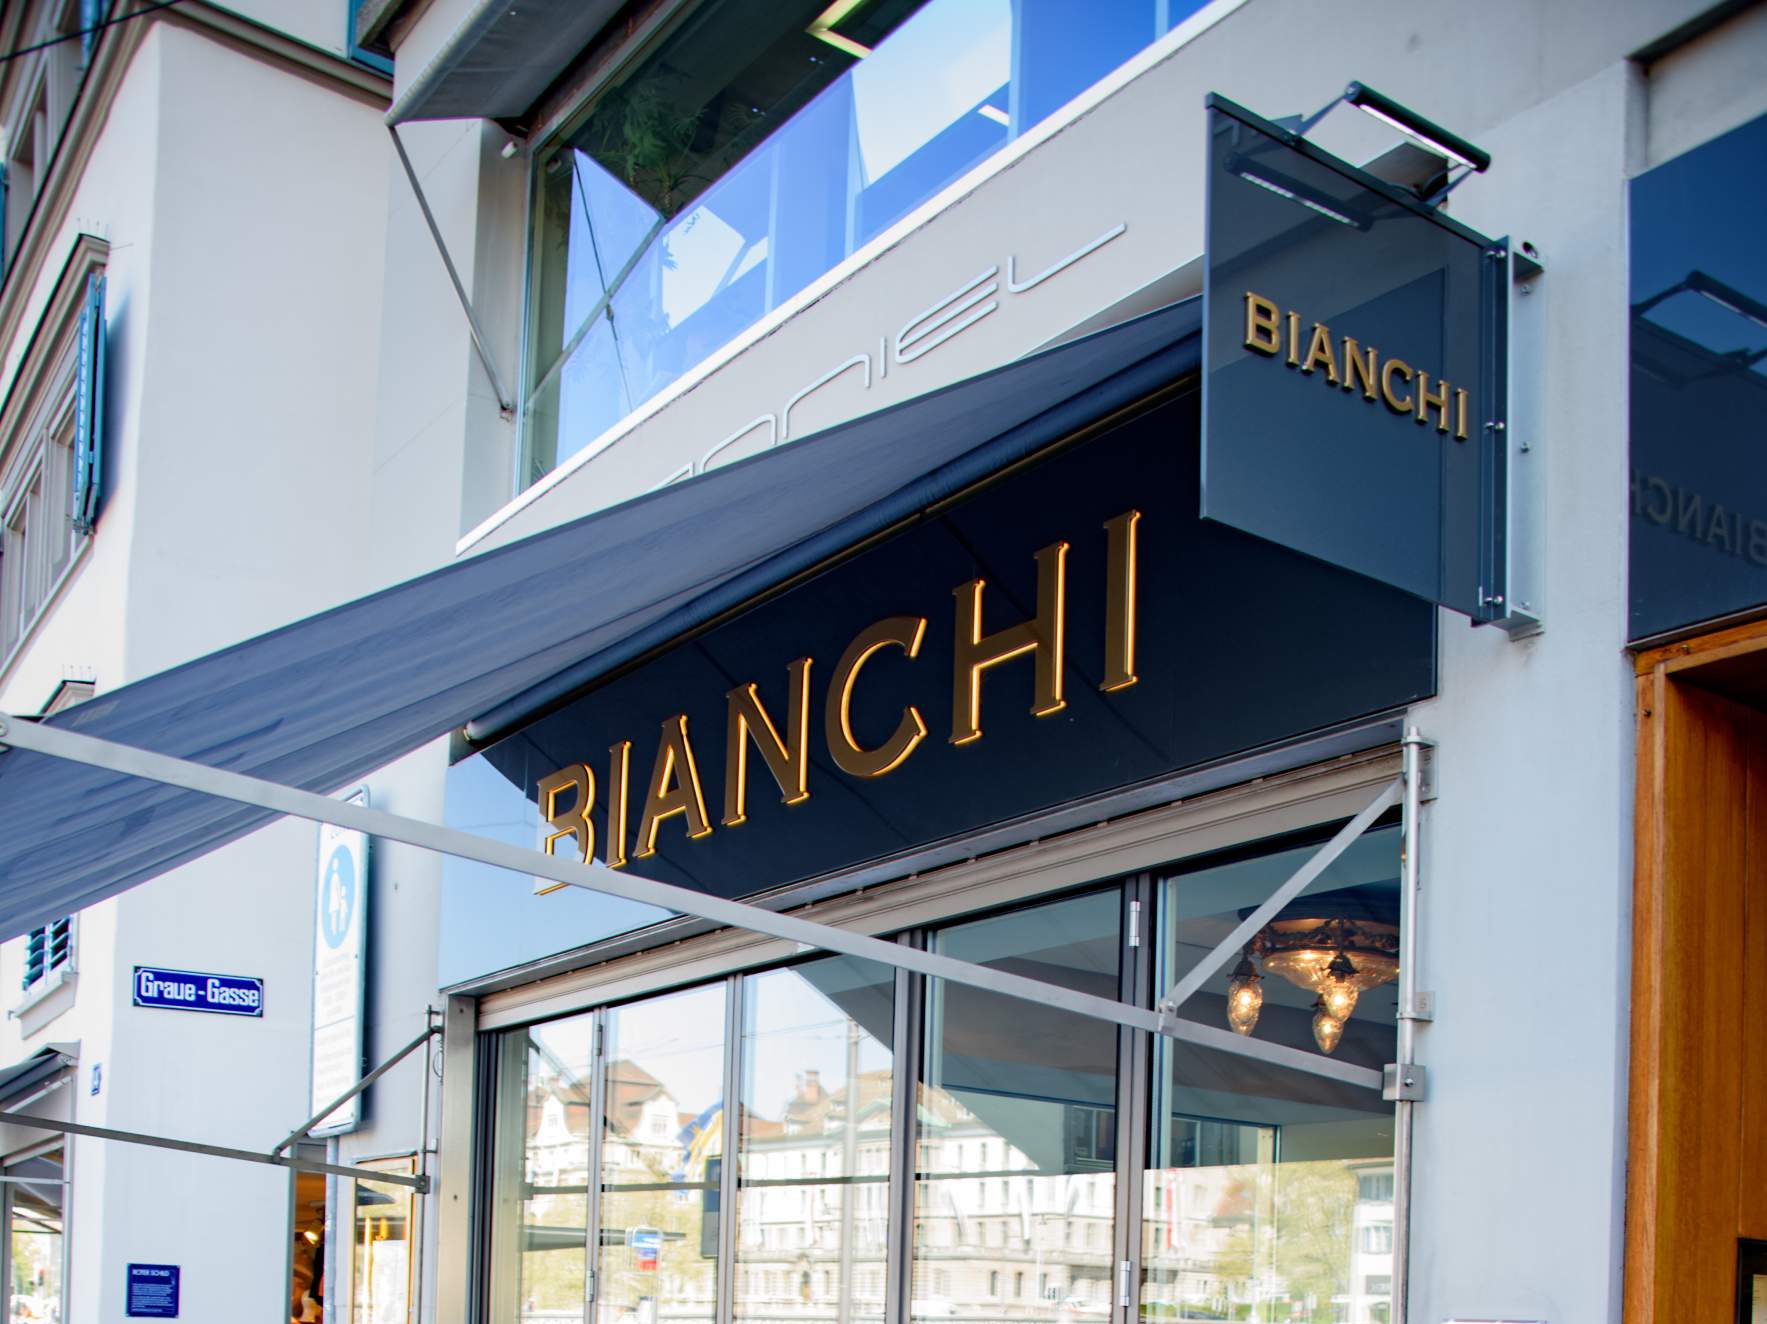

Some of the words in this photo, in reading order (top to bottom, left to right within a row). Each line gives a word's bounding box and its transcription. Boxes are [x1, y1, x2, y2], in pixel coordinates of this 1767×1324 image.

[1243, 291, 1469, 443] BIANCHI
[535, 510, 1141, 895] BIANCHI
[140, 972, 259, 1007] Graue-Gasse
